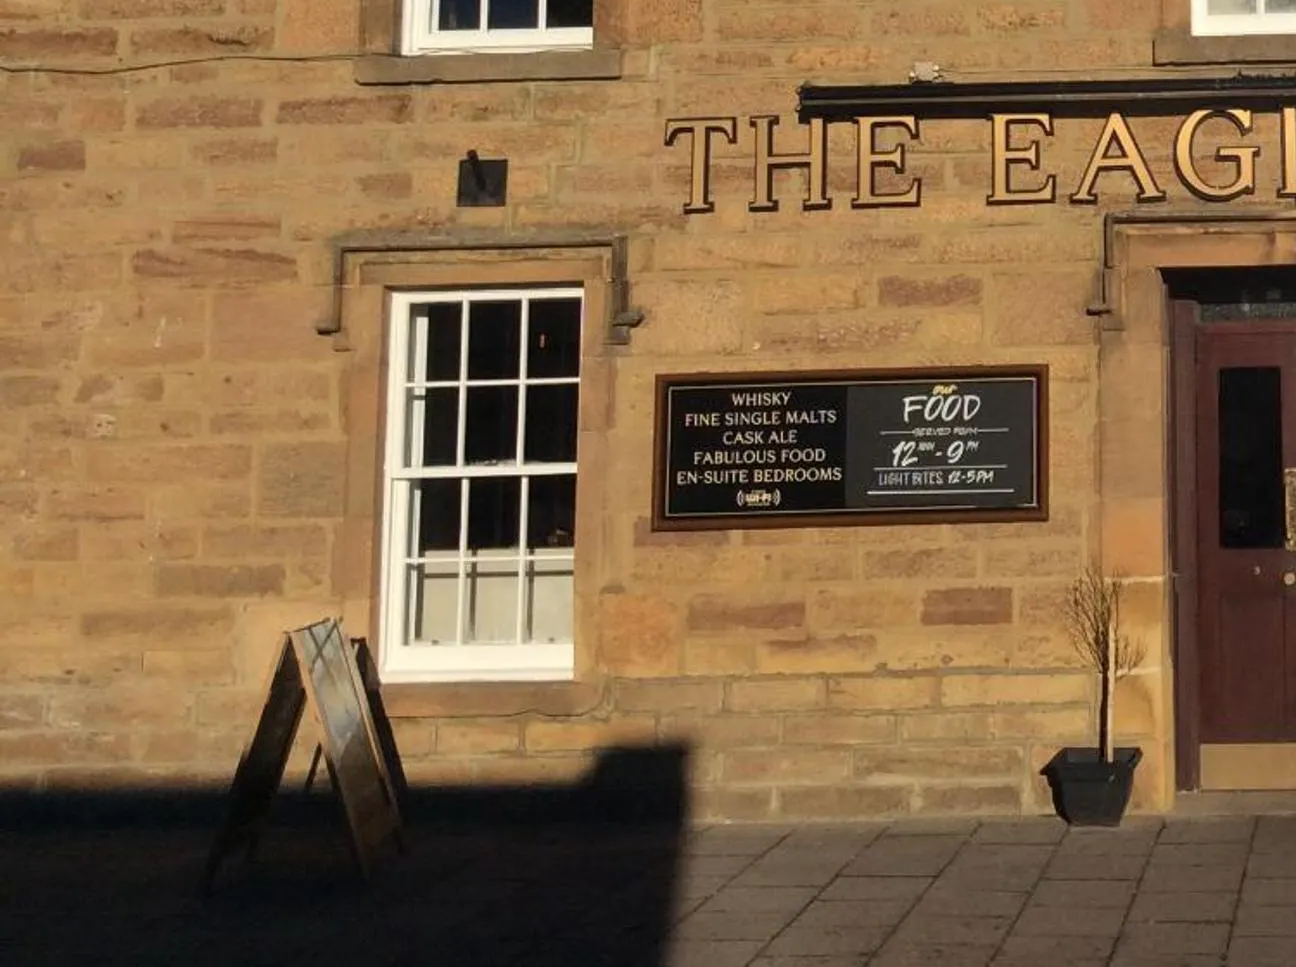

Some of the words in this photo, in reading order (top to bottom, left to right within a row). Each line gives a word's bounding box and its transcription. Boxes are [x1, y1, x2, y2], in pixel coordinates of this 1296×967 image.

[664, 114, 922, 214] THE
[732, 392, 792, 406] WHISKY
[902, 394, 981, 423] FOOD
[685, 413, 721, 427] FINE
[724, 411, 781, 426] SINGLE
[785, 409, 837, 424] MALTS
[723, 430, 764, 445] CASK
[768, 429, 798, 444] ALE
[693, 450, 776, 465] FABULOUS
[781, 448, 826, 463] FOOD
[676, 469, 749, 485] EN-SUITE
[753, 467, 842, 483] BEDROOMS
[878, 472, 910, 486] LIGHT
[911, 471, 944, 486] BITES
